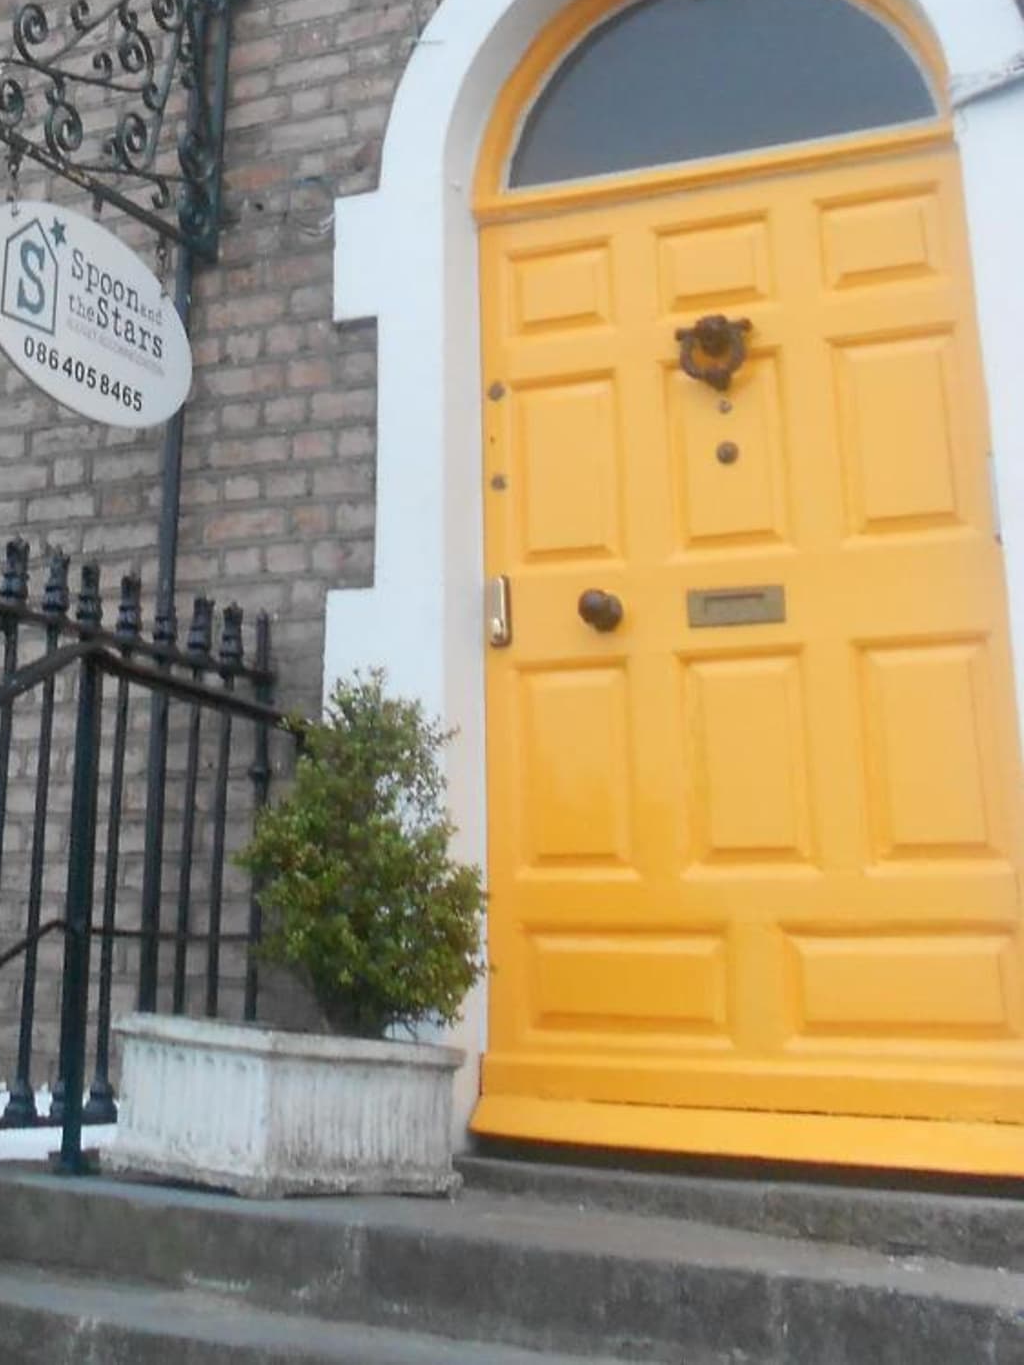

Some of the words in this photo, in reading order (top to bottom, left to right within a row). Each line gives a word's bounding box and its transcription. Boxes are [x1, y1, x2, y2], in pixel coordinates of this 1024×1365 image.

[71, 247, 138, 313] Spoon
[69, 294, 95, 323] the
[97, 296, 163, 359] Stars
